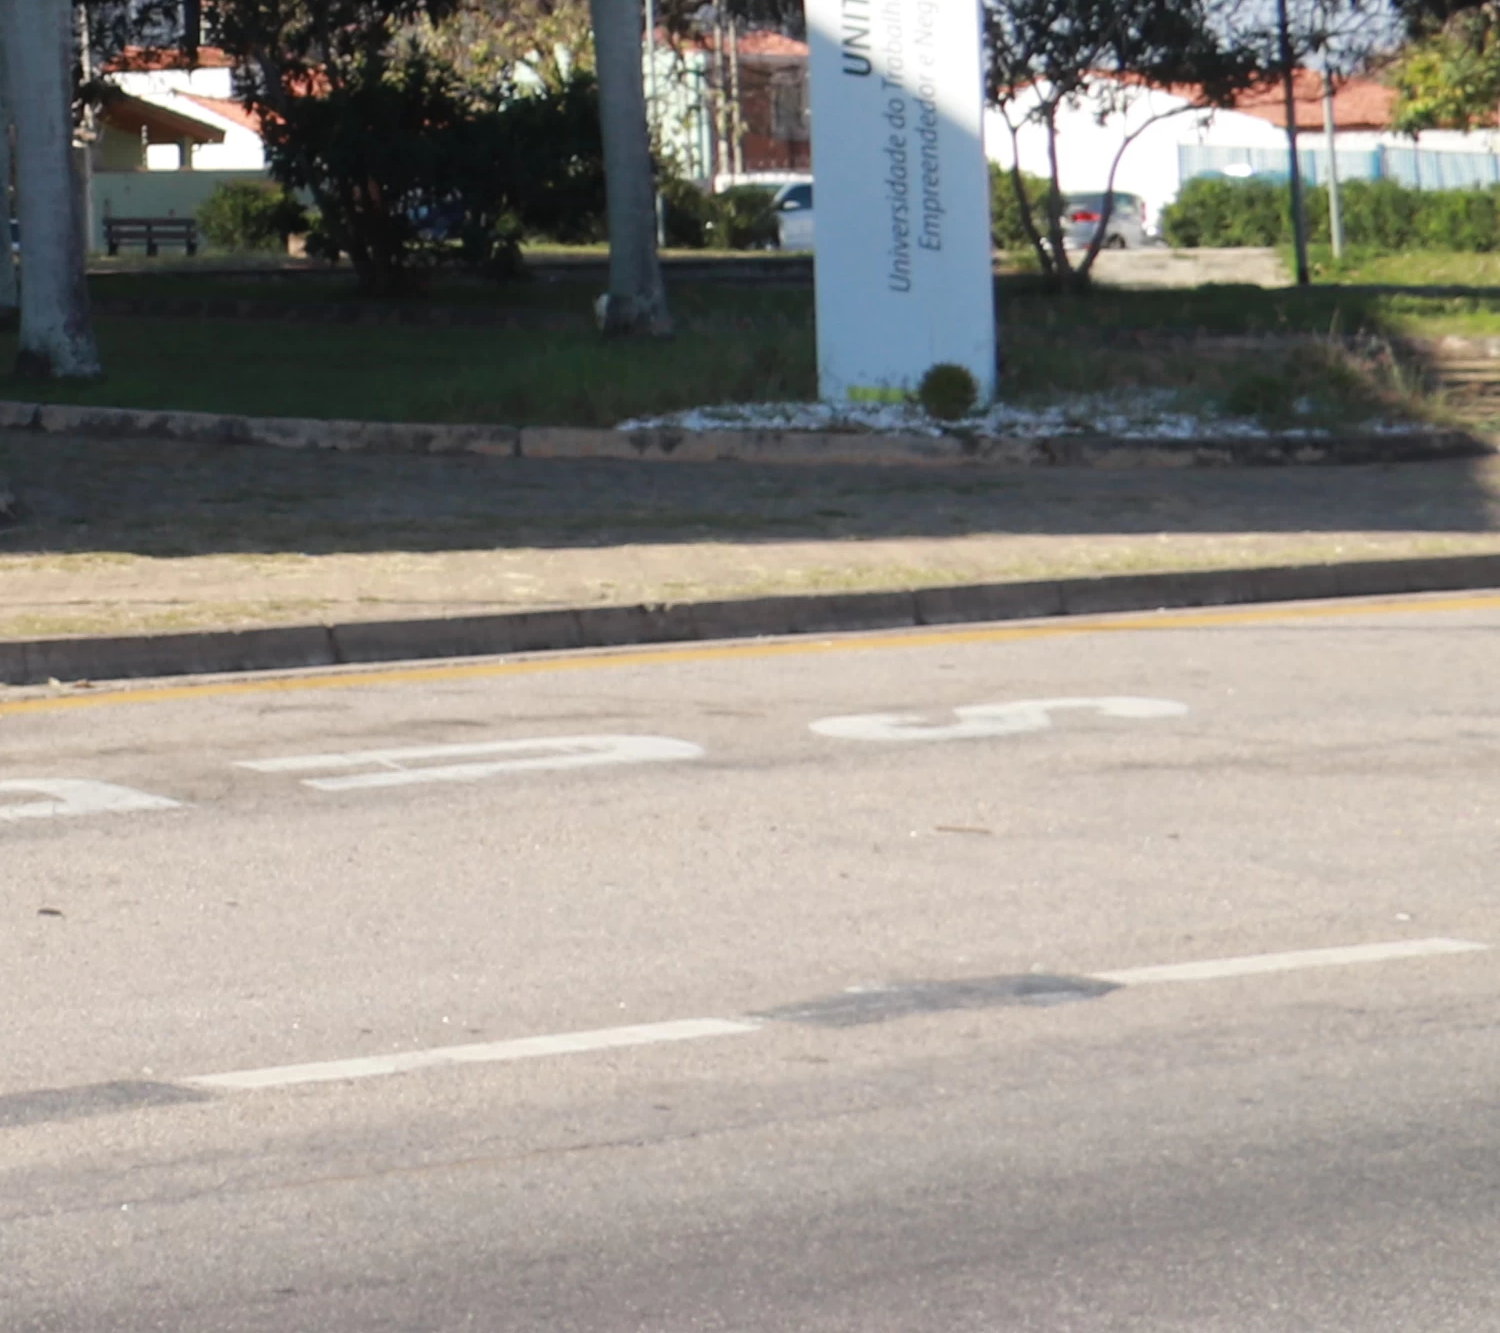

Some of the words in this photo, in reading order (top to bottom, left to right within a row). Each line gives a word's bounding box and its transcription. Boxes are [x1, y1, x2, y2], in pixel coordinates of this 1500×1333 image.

[919, 53, 936, 67] e
[882, 97, 907, 130] do
[912, 73, 946, 251] Empreendedor
[883, 134, 912, 293] Universidade
